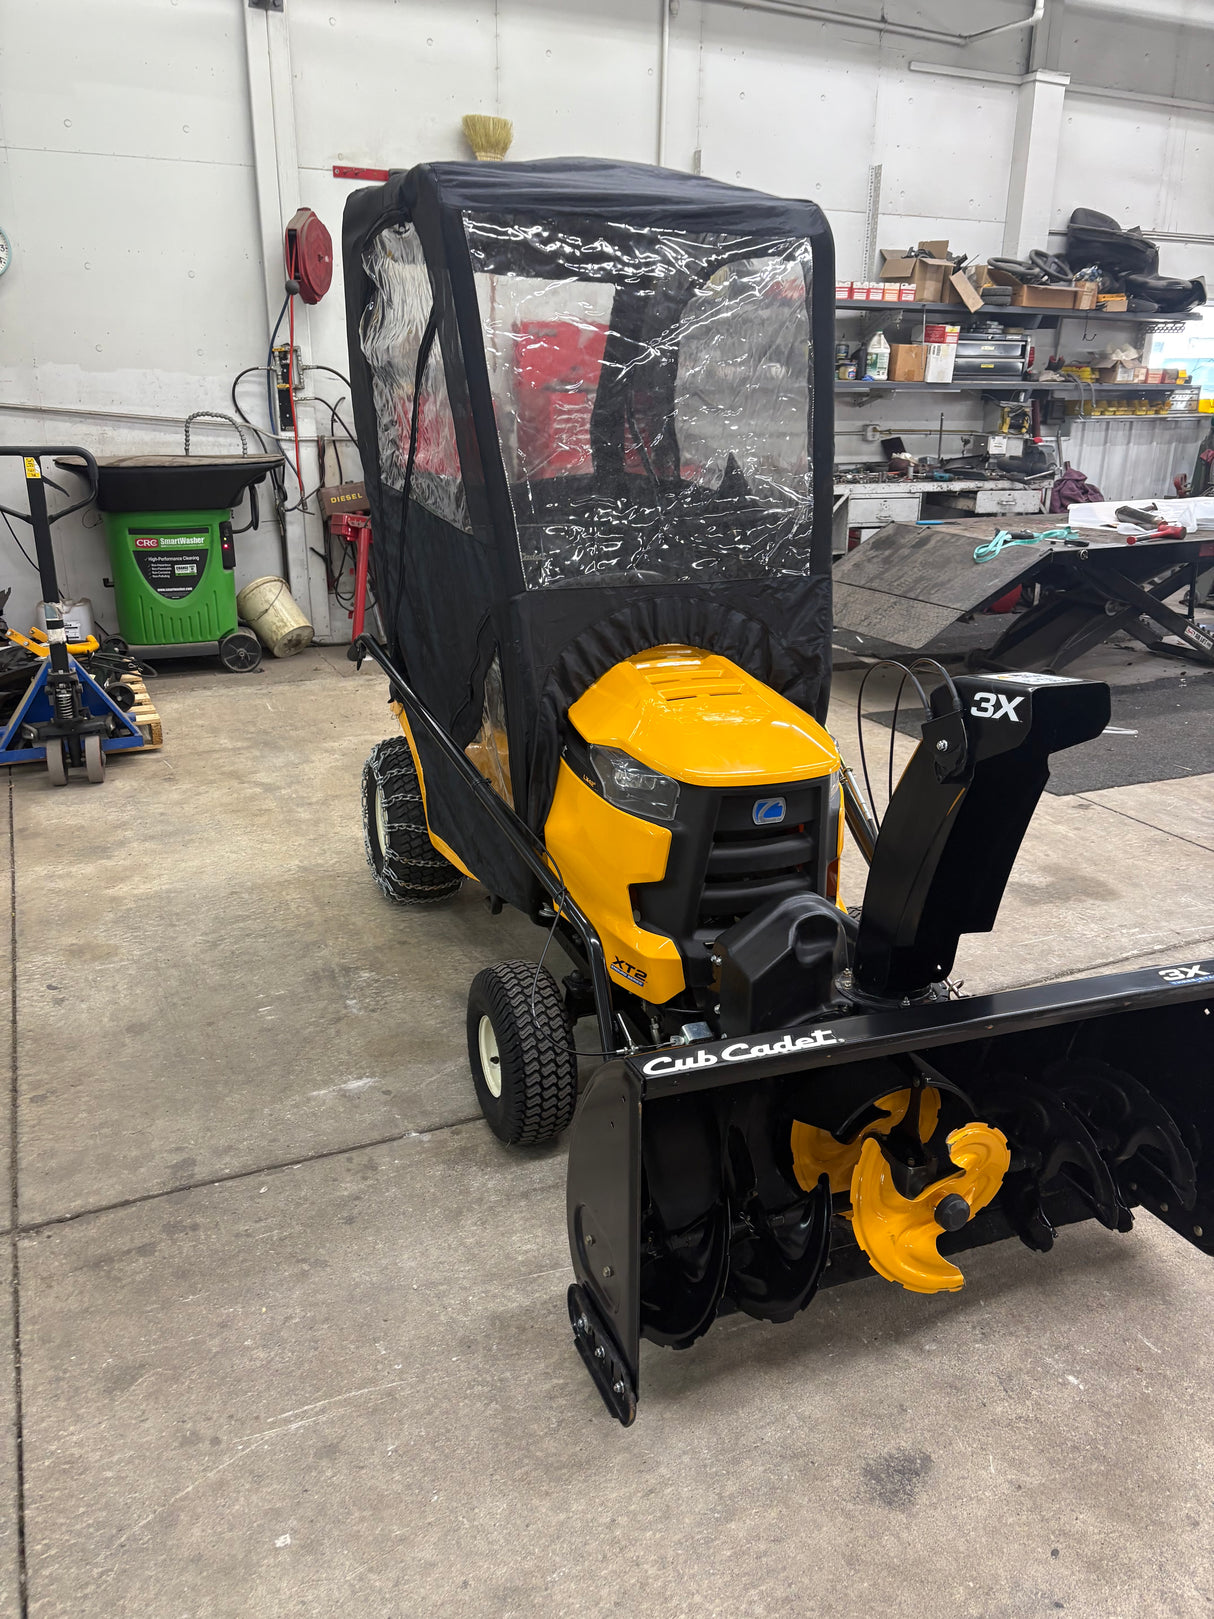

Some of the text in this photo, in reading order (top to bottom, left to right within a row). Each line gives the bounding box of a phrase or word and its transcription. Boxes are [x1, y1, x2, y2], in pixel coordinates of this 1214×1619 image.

[330, 493, 363, 504] DIESEL
[136, 537, 205, 547] CRC SmartWasher
[970, 692, 1025, 722] 3X
[612, 955, 648, 982] XT2
[1158, 964, 1211, 981] 3X
[643, 1029, 839, 1075] Cub Cadet
